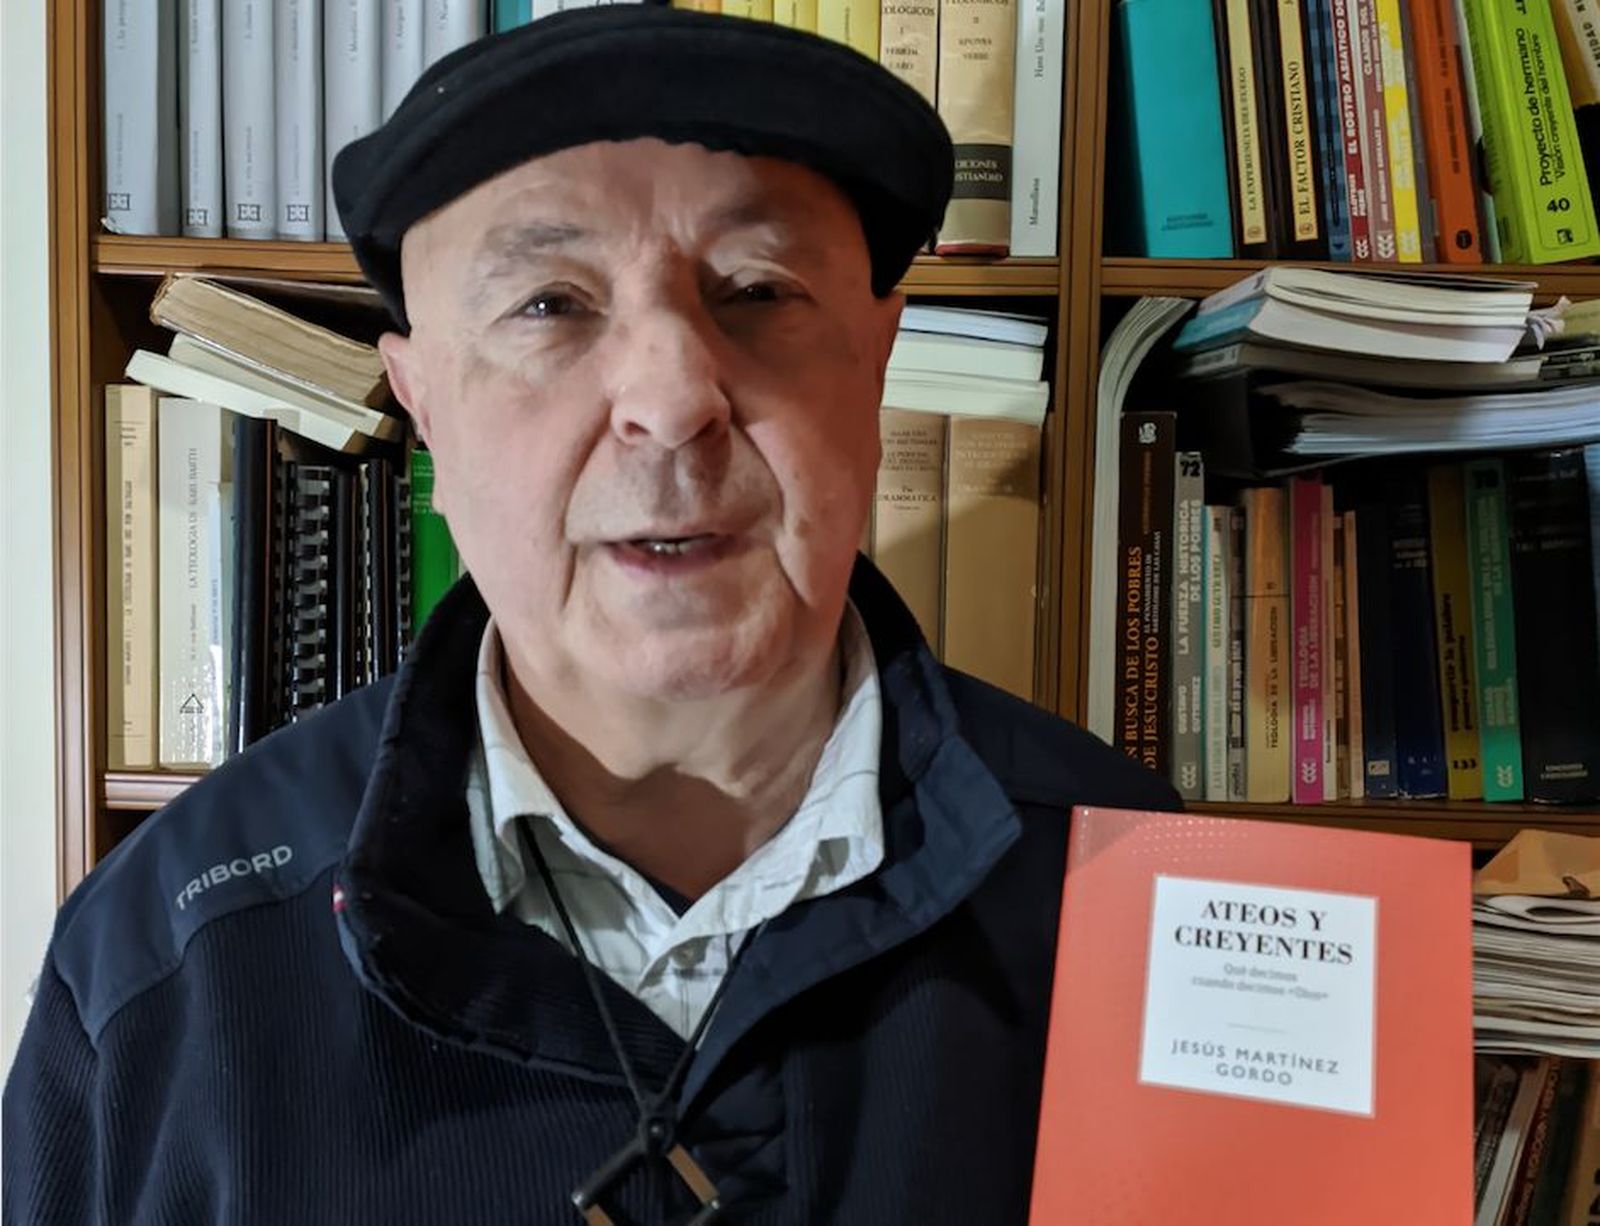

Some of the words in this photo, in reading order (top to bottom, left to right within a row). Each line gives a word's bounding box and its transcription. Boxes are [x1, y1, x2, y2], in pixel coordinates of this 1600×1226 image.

[1336, 19, 1351, 81] ASIATICO
[1361, 28, 1373, 75] CLAMOR
[1513, 28, 1536, 95] hermano
[1530, 33, 1546, 76] hombre
[1287, 60, 1304, 133] CRISTIANO
[1538, 77, 1550, 94] del
[1343, 84, 1357, 137] ROSTRO
[1524, 97, 1540, 115] de
[1542, 97, 1562, 143] creyente
[1348, 140, 1358, 154] EL
[1531, 118, 1553, 186] Proyecto
[1550, 144, 1566, 180] Visión
[1295, 139, 1310, 193] FACTOR
[1298, 198, 1311, 215] EL
[1546, 197, 1570, 213] 40
[188, 447, 197, 480] BARTH
[1181, 460, 1201, 478] 72
[1178, 499, 1189, 575] HISTORICA
[1190, 499, 1201, 553] POBRES
[188, 524, 197, 574] TEOLOGIA
[188, 576, 197, 589] LA
[1127, 546, 1142, 613] POBRES
[1190, 555, 1200, 581] LOS
[1179, 581, 1189, 634] FUERZA
[1190, 584, 1200, 602] DE
[1127, 616, 1140, 651] LOS
[1179, 636, 1189, 655] LA
[1126, 653, 1140, 679] DE
[1308, 652, 1318, 670] LA
[1144, 636, 1159, 740] JESUCRISTO
[1125, 682, 1139, 740] BUSCA
[1178, 685, 1188, 735] GUSTAVO
[175, 845, 293, 911] TRIBORD
[1200, 899, 1298, 929] ATEOS
[1308, 910, 1328, 931] Y
[1174, 925, 1354, 965] CREYENTES
[1192, 975, 1235, 991] cuando
[1236, 979, 1286, 996] decimos
[1223, 962, 1247, 976] Qué
[1249, 966, 1298, 983] decimos
[1171, 1039, 1226, 1059] JESÚS
[1236, 1047, 1340, 1075] MARTÍNEZ
[1215, 1062, 1293, 1086] GORDO
